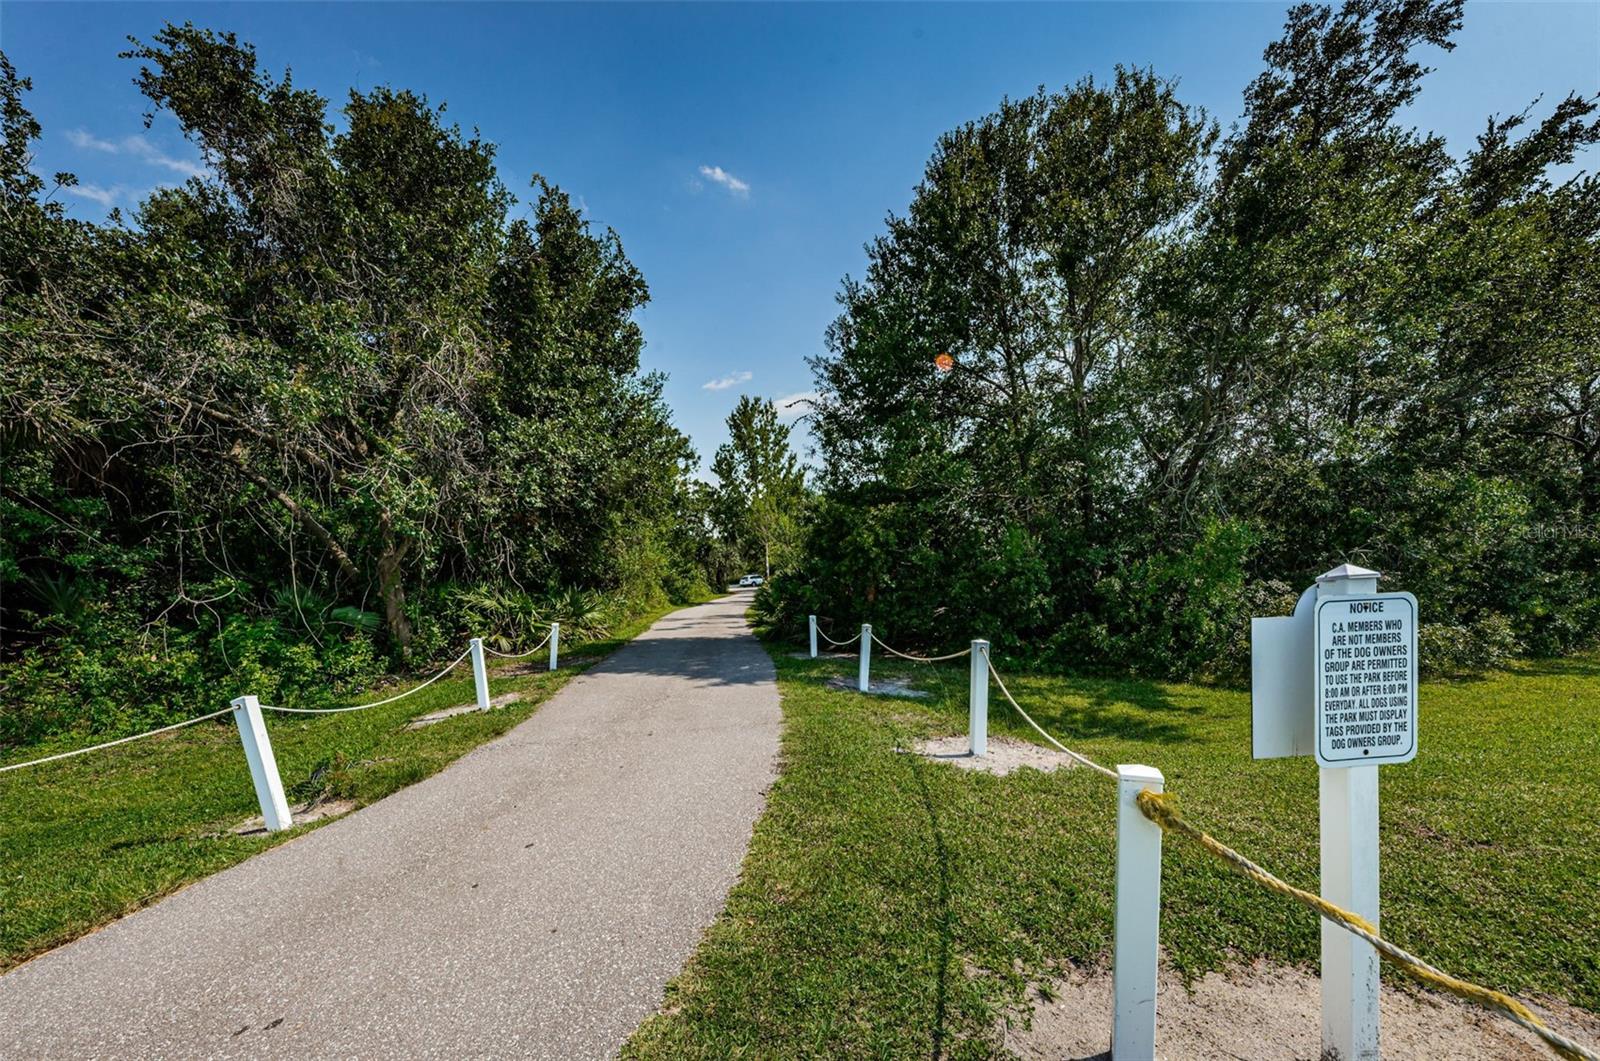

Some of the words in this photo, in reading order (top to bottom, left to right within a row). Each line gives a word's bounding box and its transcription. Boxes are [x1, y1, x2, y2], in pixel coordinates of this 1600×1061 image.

[1350, 602, 1384, 613] NOTICE
[1332, 622, 1345, 633] C.A.
[1348, 621, 1383, 632] MEMBERS
[1385, 620, 1402, 630] WHO
[1332, 635, 1346, 646] ARE
[1348, 634, 1363, 645] NOT
[1365, 633, 1401, 644] MEMBERS
[1325, 649, 1335, 659] OF
[1338, 648, 1352, 658] THE
[1355, 647, 1370, 657] DOG
[1373, 645, 1407, 657] OWNERS
[1325, 661, 1349, 672] GROUP
[1351, 660, 1365, 670] ARE
[1367, 658, 1407, 670] PERMITTED
[1325, 675, 1334, 685] TO
[1335, 674, 1348, 685] USE
[1350, 673, 1362, 683] THE
[1364, 672, 1381, 682] PARK
[1383, 671, 1407, 681] BEFORE
[1325, 688, 1338, 698] 8:00
[1340, 687, 1349, 697] AM
[1351, 686, 1360, 696] OR
[1362, 685, 1381, 695] AFTER
[1383, 684, 1396, 694] 6:00
[1398, 683, 1407, 693] PM
[1325, 700, 1357, 711] EVERYDAY.
[1359, 699, 1369, 708] ALL
[1371, 698, 1387, 708] DOGS
[1389, 696, 1407, 707] USING
[1325, 713, 1337, 724] THE
[1340, 712, 1357, 723] PARK
[1359, 711, 1377, 722] MUST
[1380, 709, 1407, 720] DISPLAY
[1325, 726, 1343, 737] TAGS
[1346, 724, 1381, 735] PROVIDED
[1383, 723, 1392, 732] BY
[1394, 722, 1407, 732] THE
[1332, 739, 1345, 749] DOG
[1347, 736, 1375, 748] OWNERS
[1378, 735, 1402, 745] GROUP.
